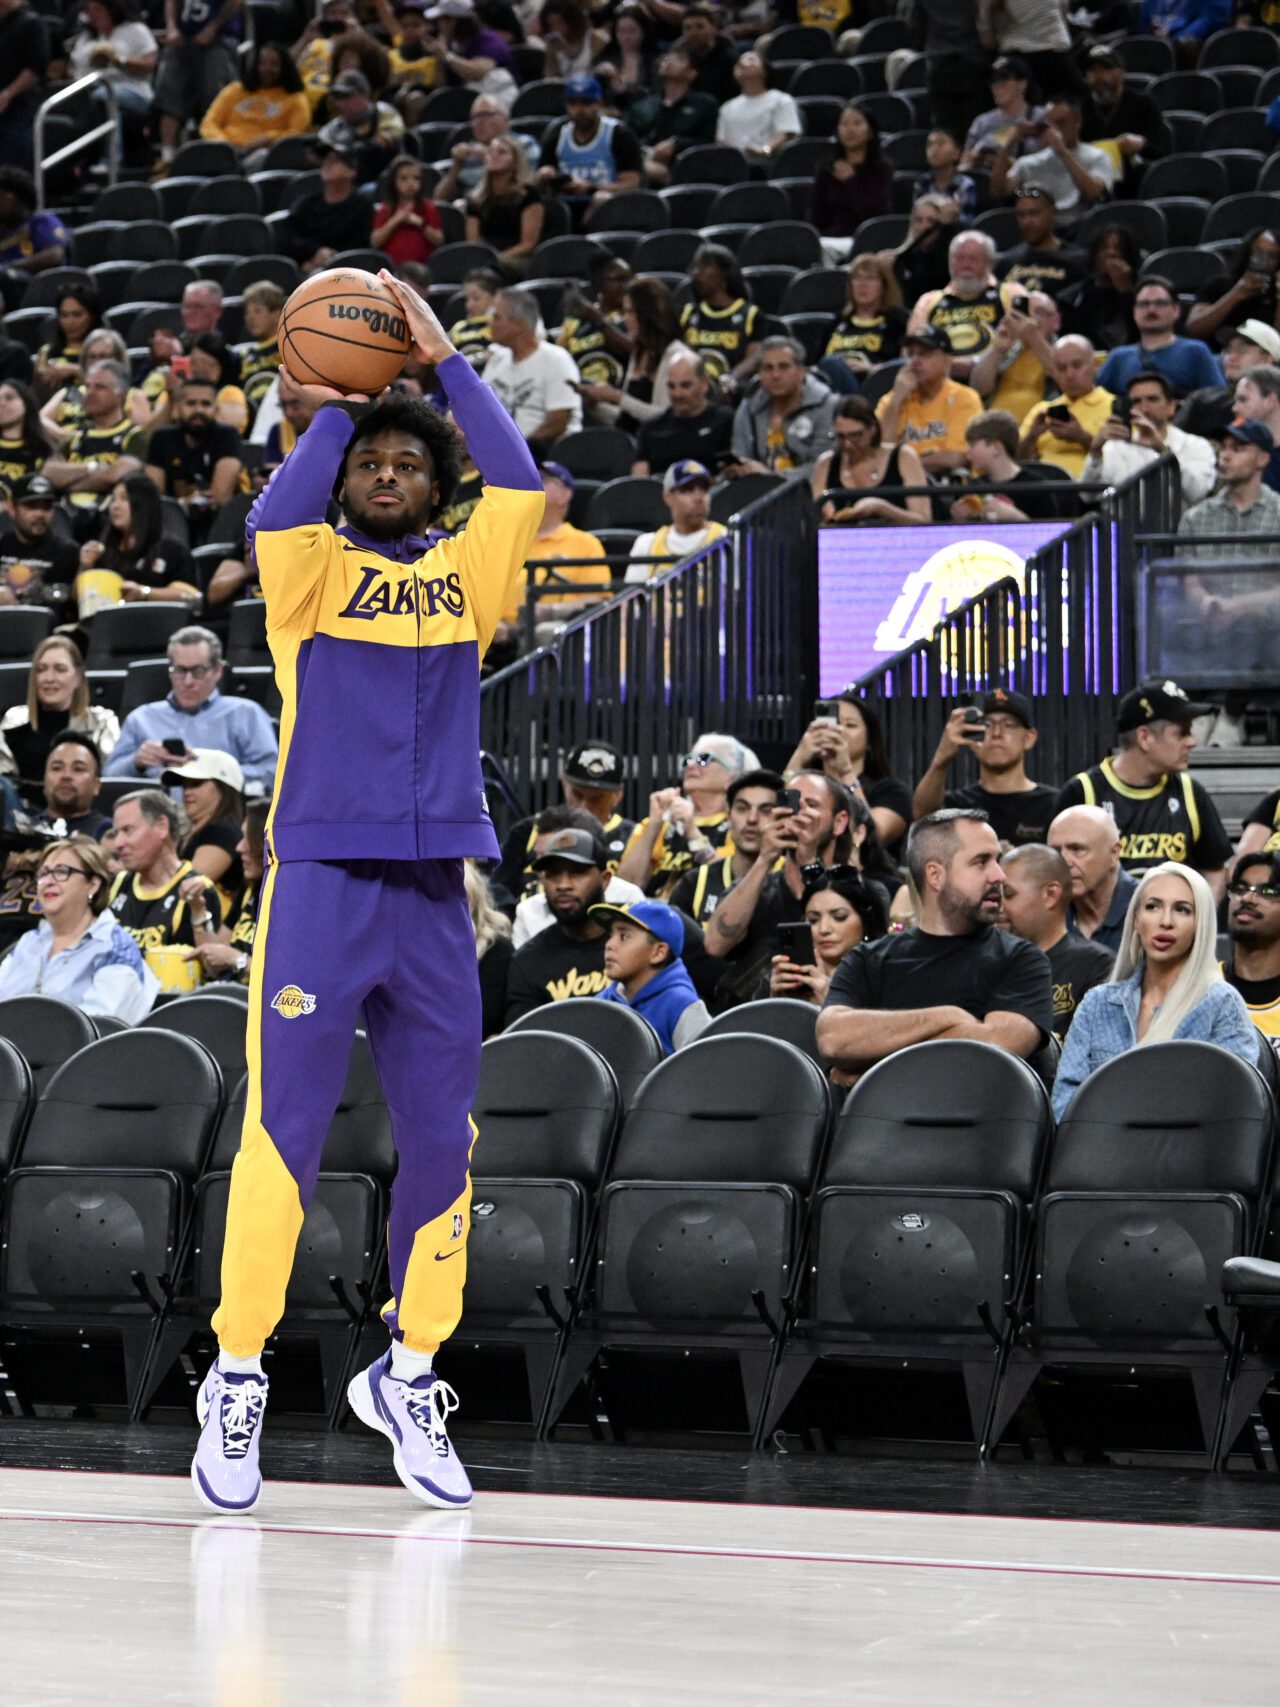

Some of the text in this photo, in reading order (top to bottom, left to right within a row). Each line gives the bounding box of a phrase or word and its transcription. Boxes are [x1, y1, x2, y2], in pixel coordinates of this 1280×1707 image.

[328, 303, 405, 344] Wilson
[1118, 831, 1187, 862] AKERS
[273, 991, 316, 1012] LAKERS
